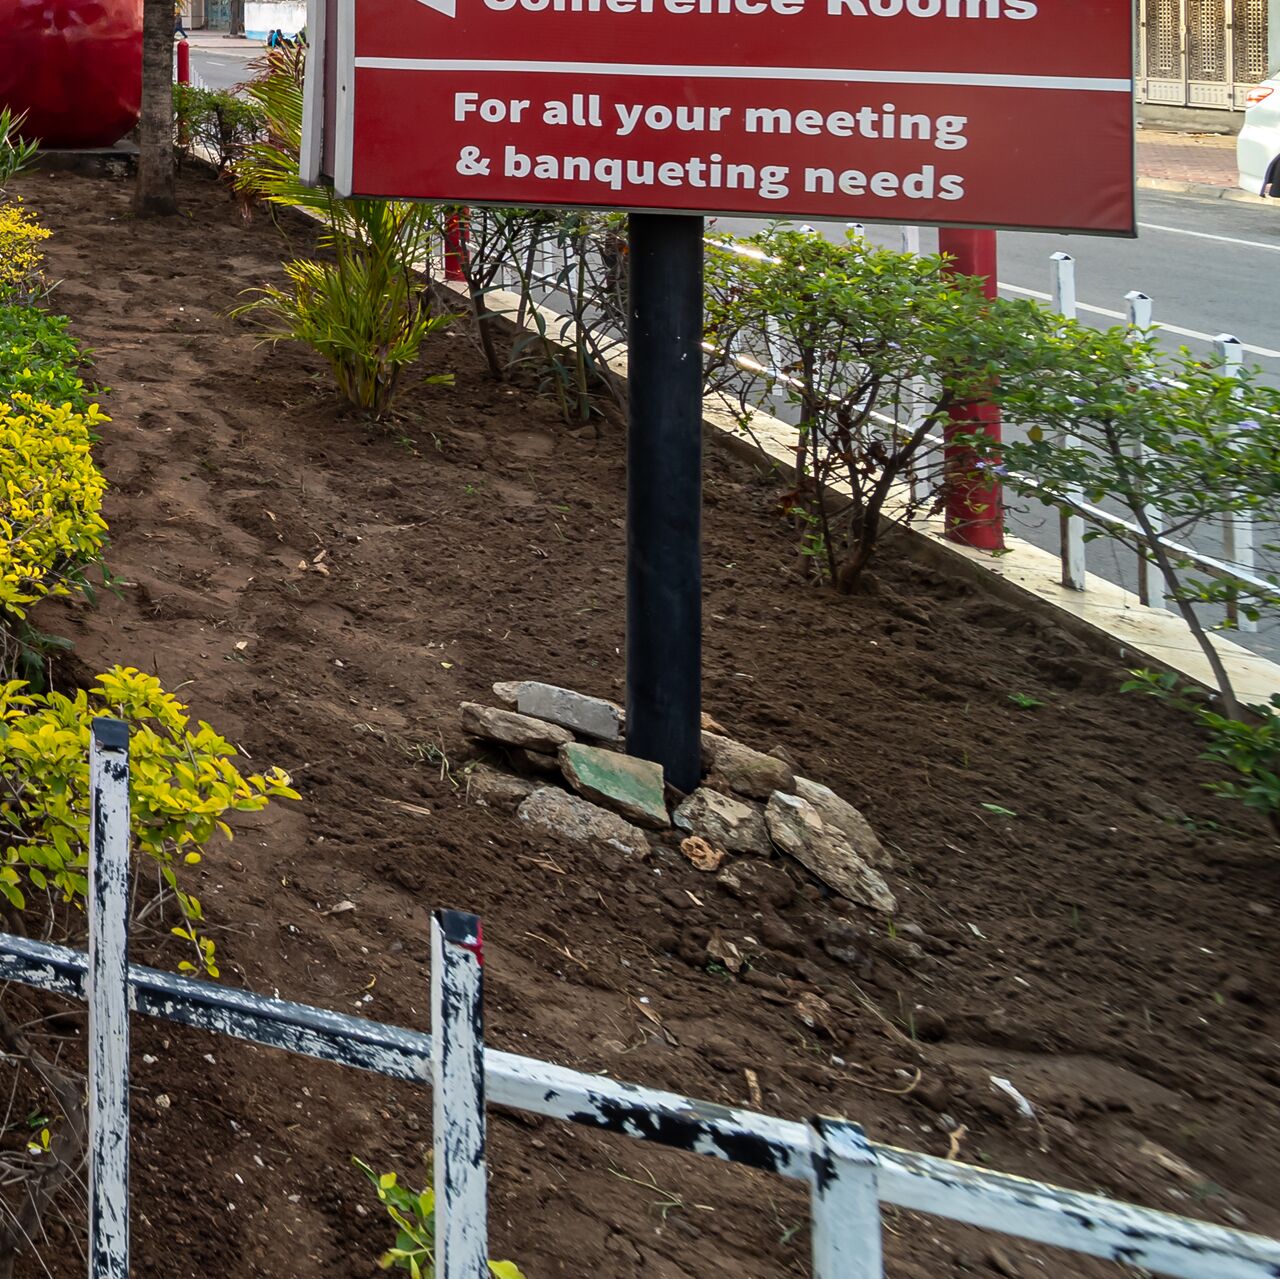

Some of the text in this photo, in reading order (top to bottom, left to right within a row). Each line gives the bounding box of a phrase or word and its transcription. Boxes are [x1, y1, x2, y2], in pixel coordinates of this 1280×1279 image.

[454, 92, 968, 150] For all your meeting
[456, 145, 964, 200] & banqueting needs
